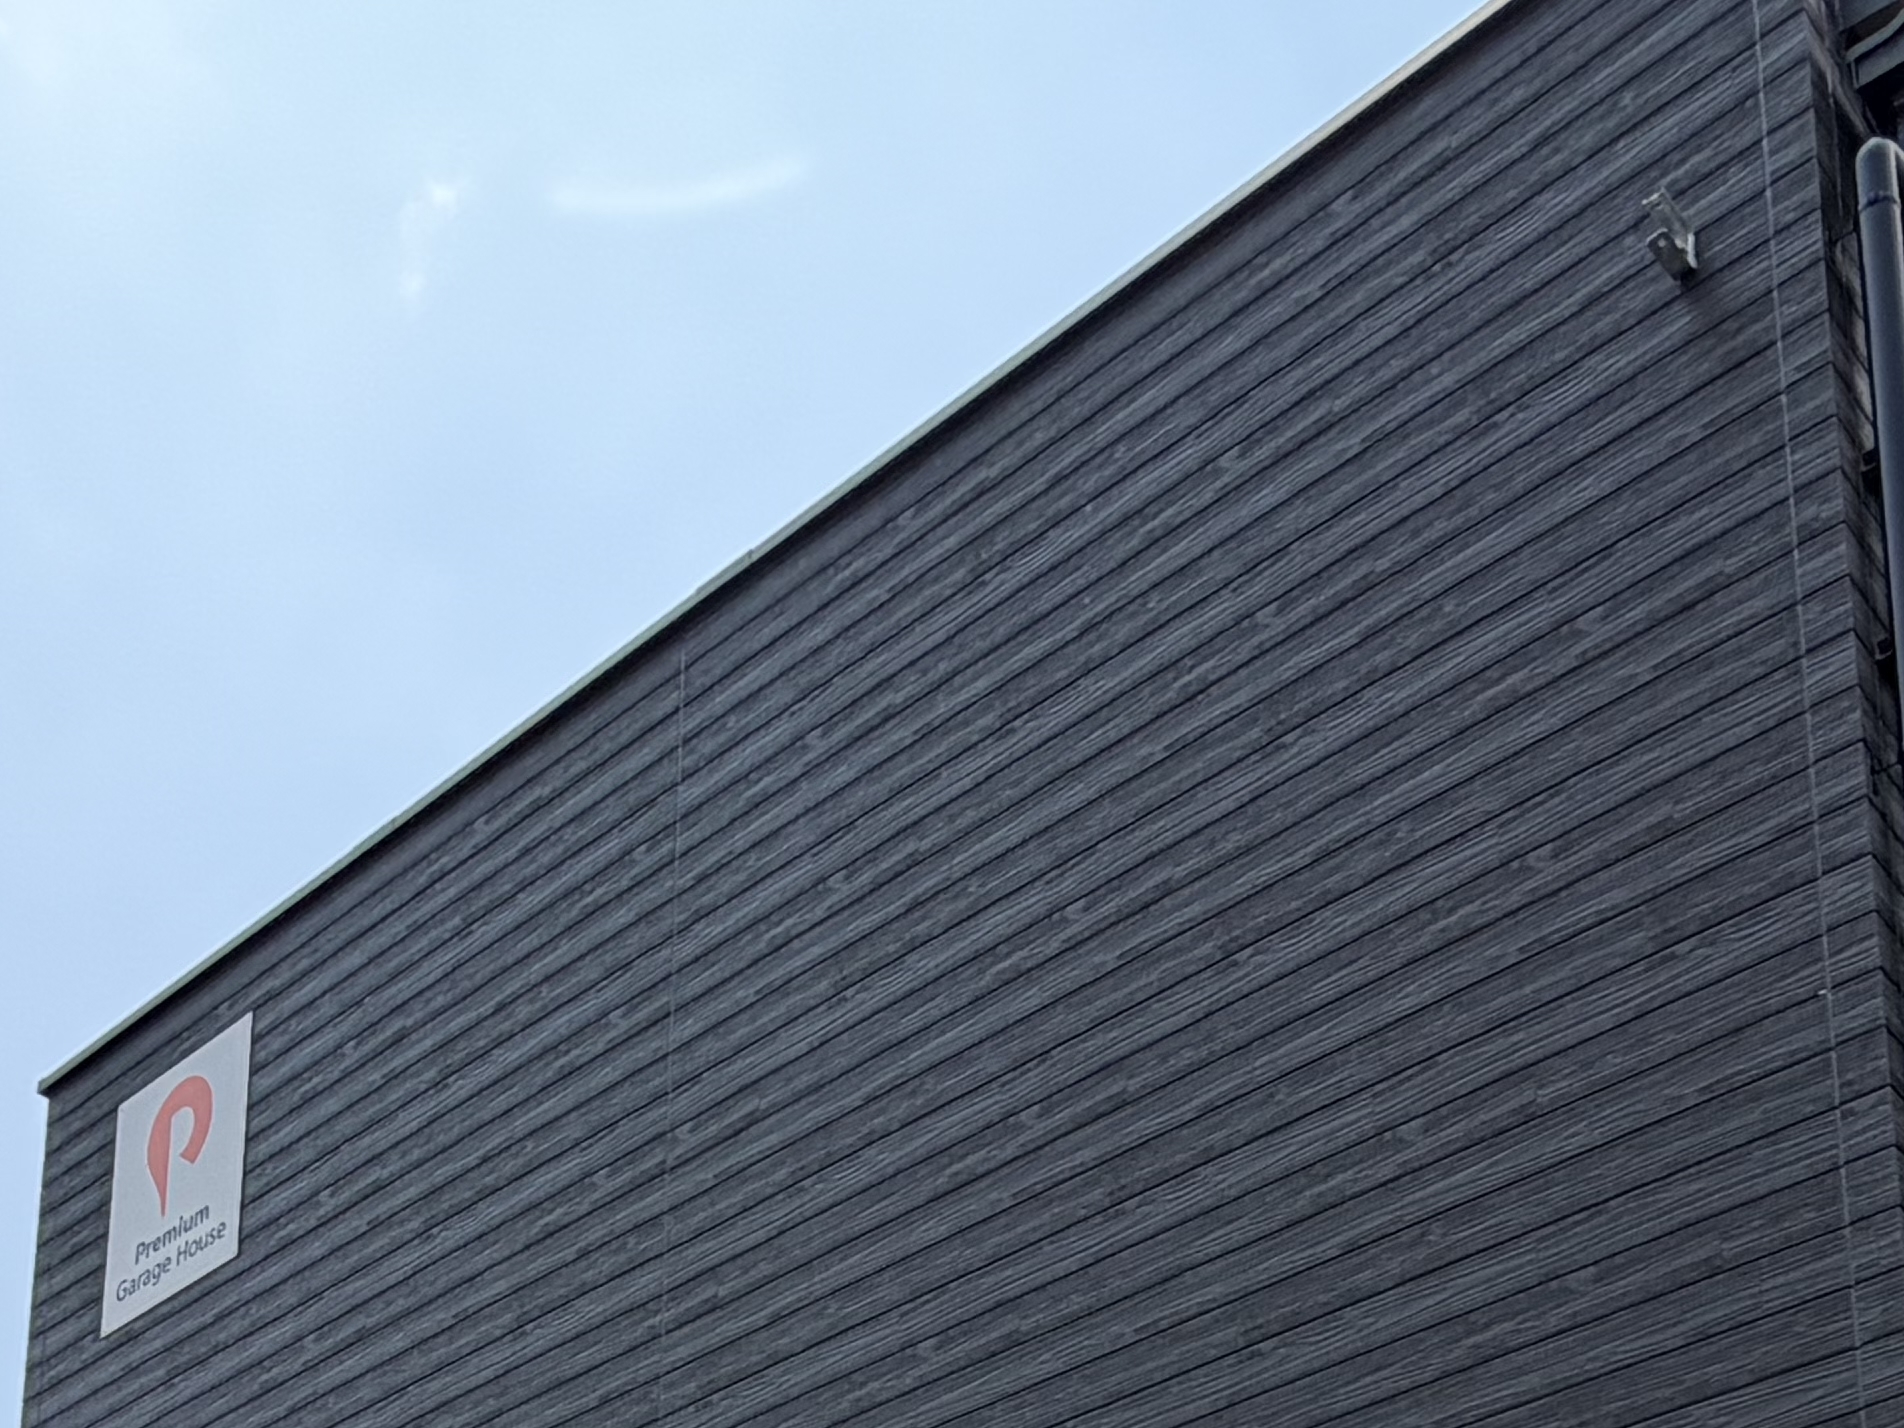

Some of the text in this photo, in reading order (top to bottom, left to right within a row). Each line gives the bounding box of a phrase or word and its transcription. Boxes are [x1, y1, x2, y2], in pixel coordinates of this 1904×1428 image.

[116, 1220, 227, 1302] Garage House
[135, 1205, 210, 1264] Premium
